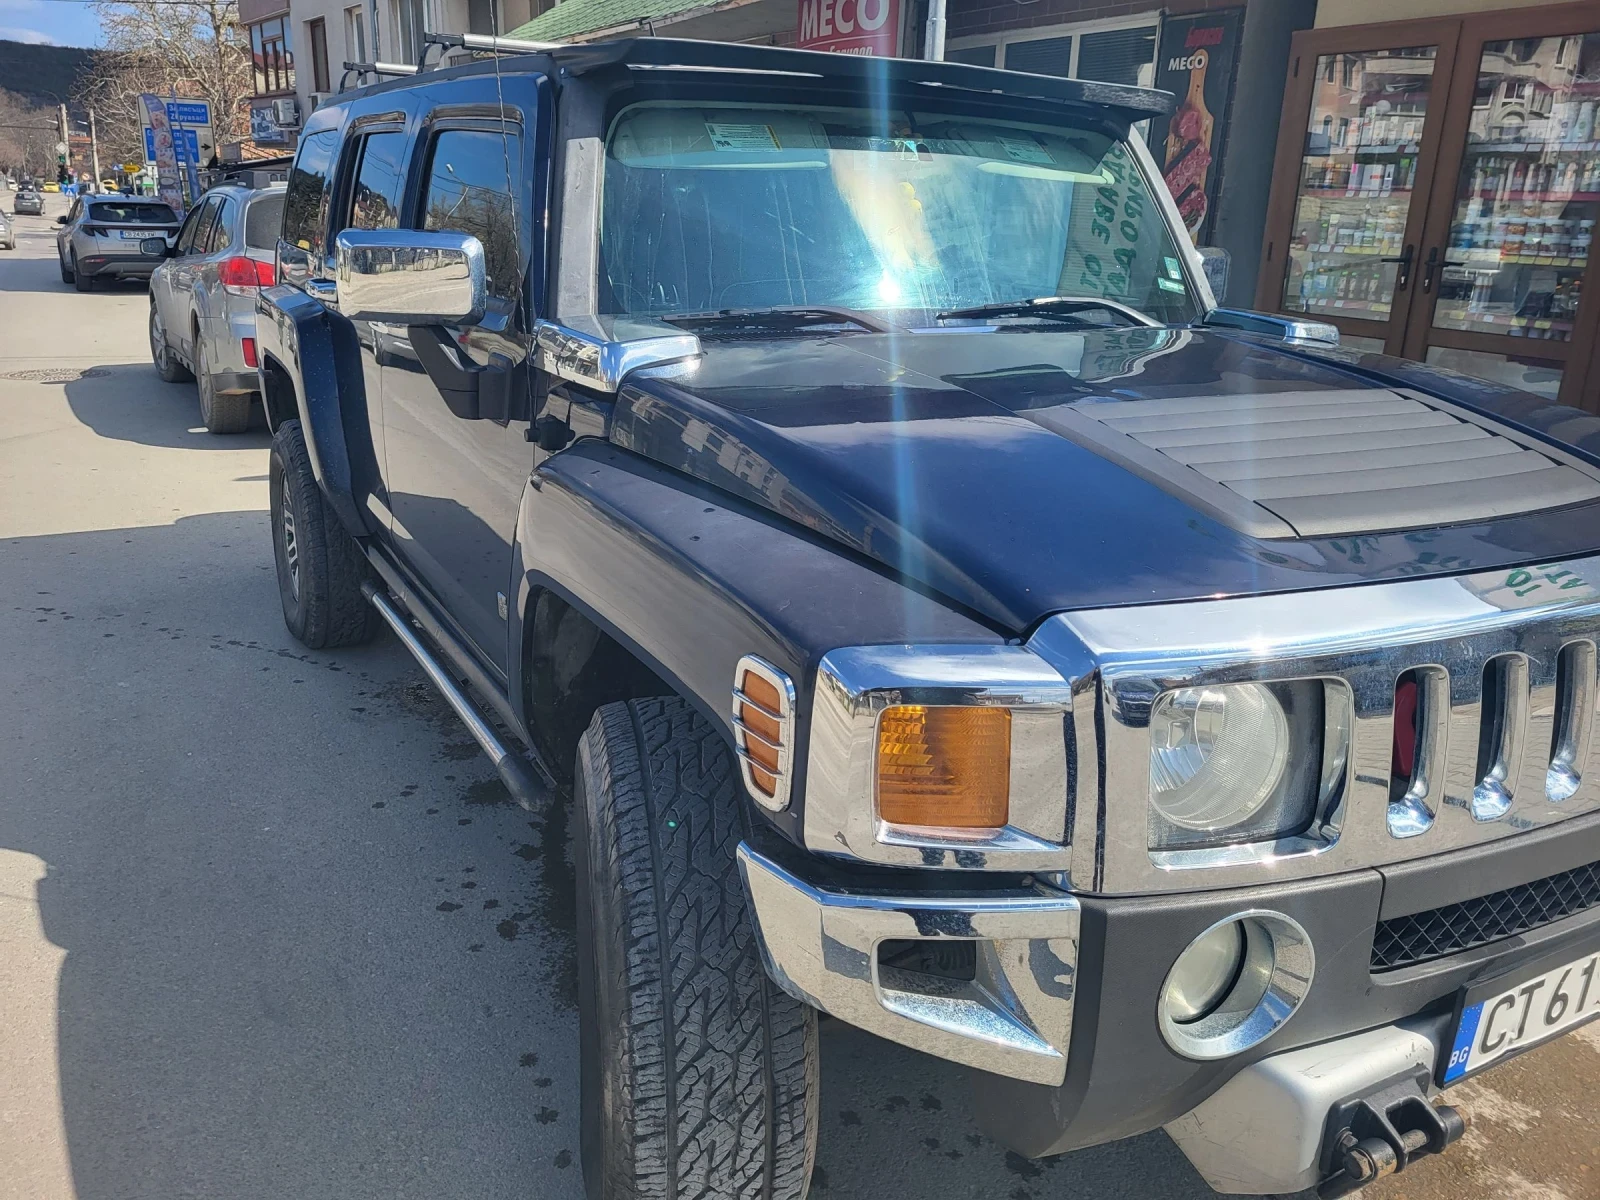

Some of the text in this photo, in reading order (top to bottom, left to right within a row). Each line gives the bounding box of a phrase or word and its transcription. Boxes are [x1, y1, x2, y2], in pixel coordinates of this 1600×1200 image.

[800, 0, 890, 42] МЕСО
[1168, 55, 1206, 71] МЕСО
[1480, 956, 1600, 1055] CT 61
[1448, 1046, 1469, 1069] BG
